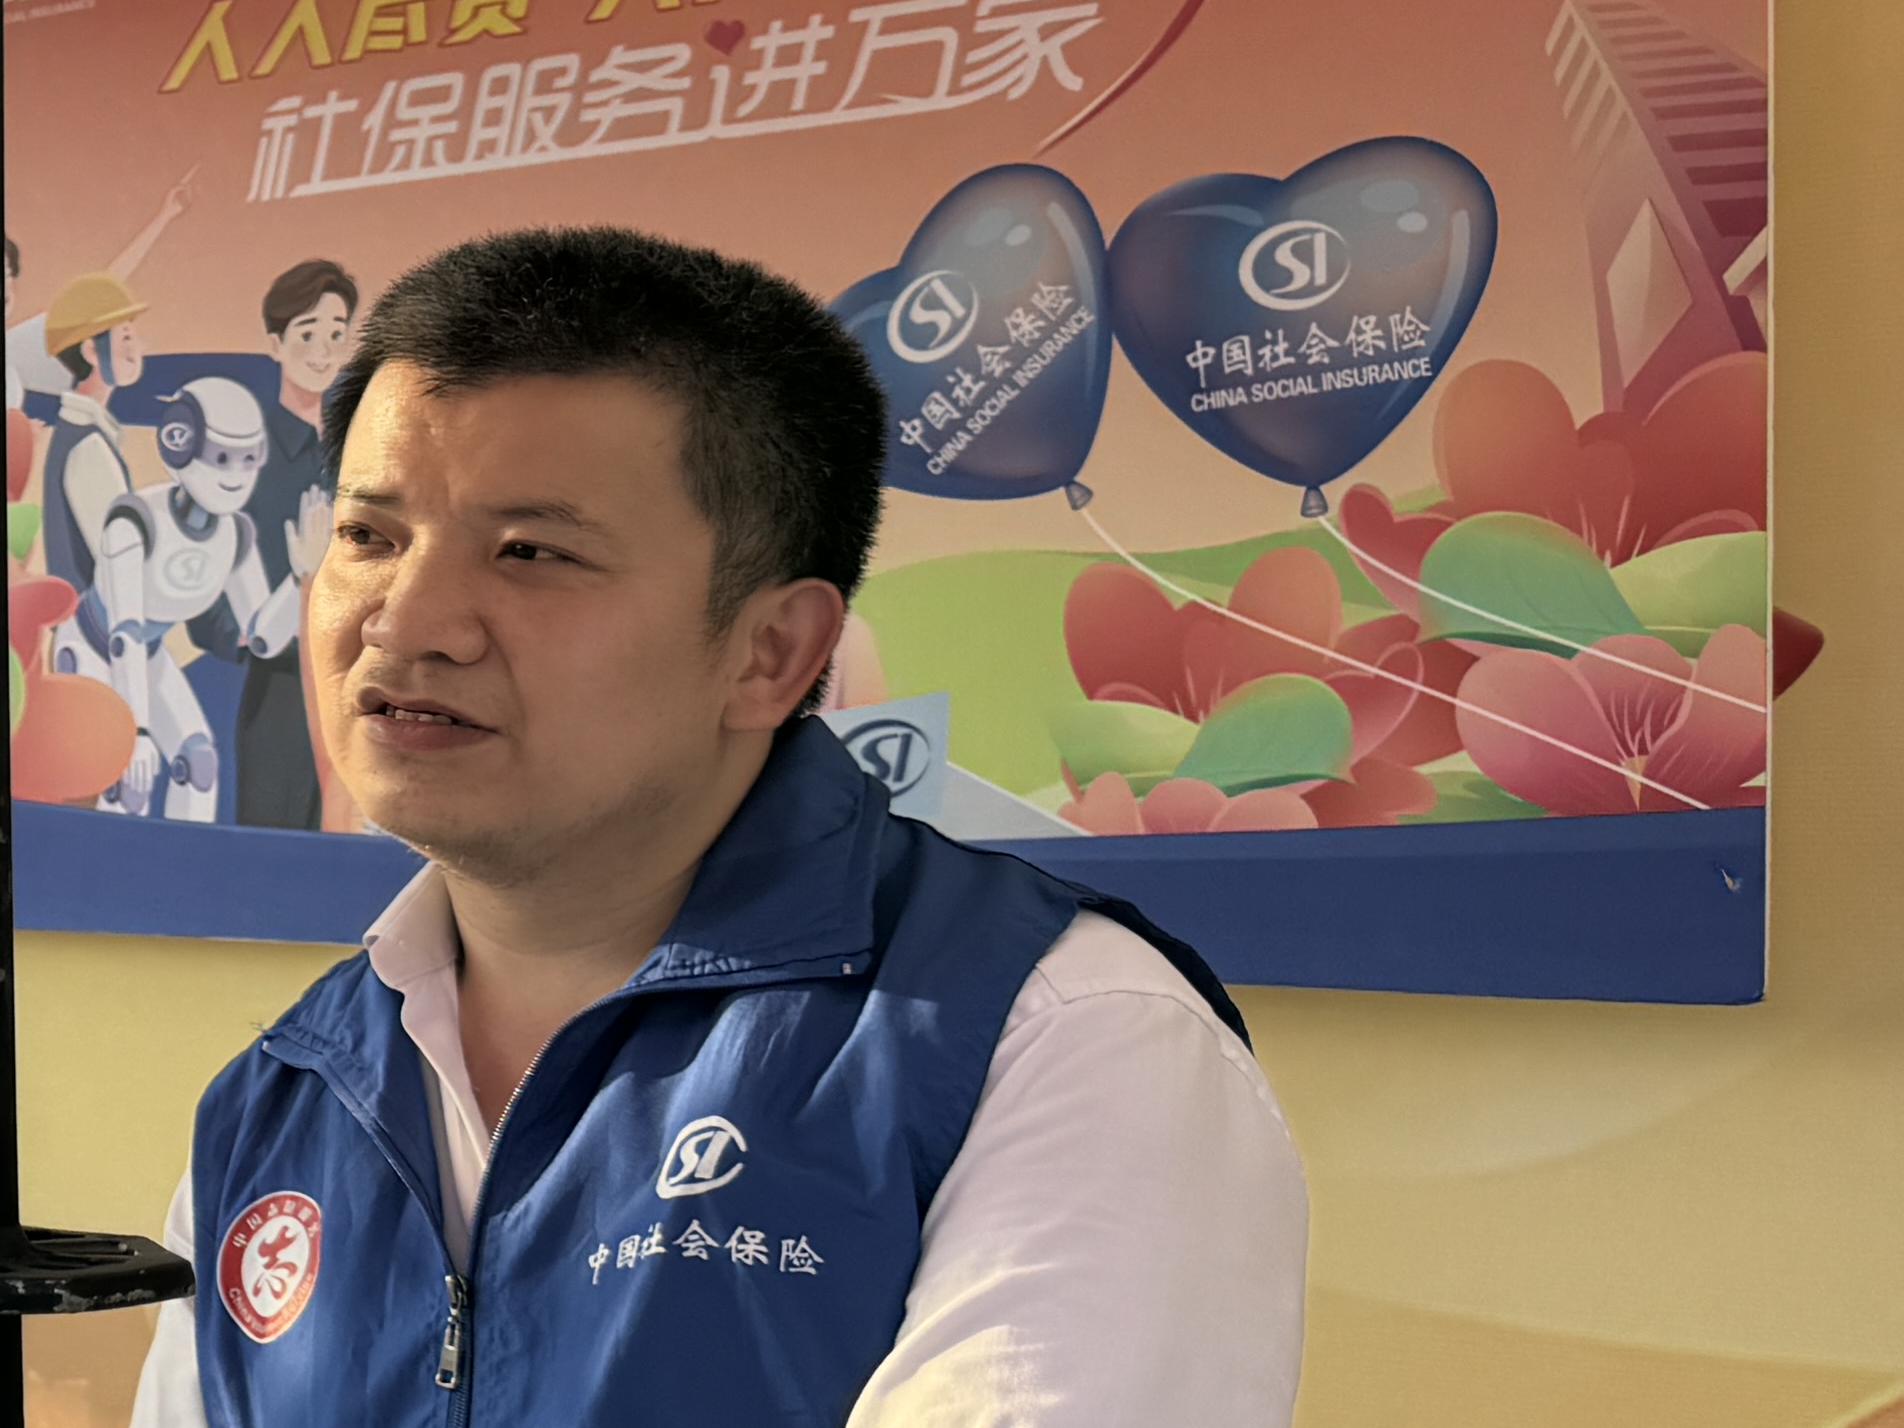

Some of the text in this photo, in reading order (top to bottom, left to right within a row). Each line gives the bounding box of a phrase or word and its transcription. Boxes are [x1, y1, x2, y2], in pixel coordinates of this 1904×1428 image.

[899, 279, 1076, 453] 中国社会保险
[1185, 305, 1431, 387] 中国社会保险
[1190, 357, 1432, 413] CHINA SOCIAL INSURANCE
[927, 305, 1097, 475] CHINA SOCIAL INSURANCE
[588, 1219, 827, 1287] 中国社会保险
